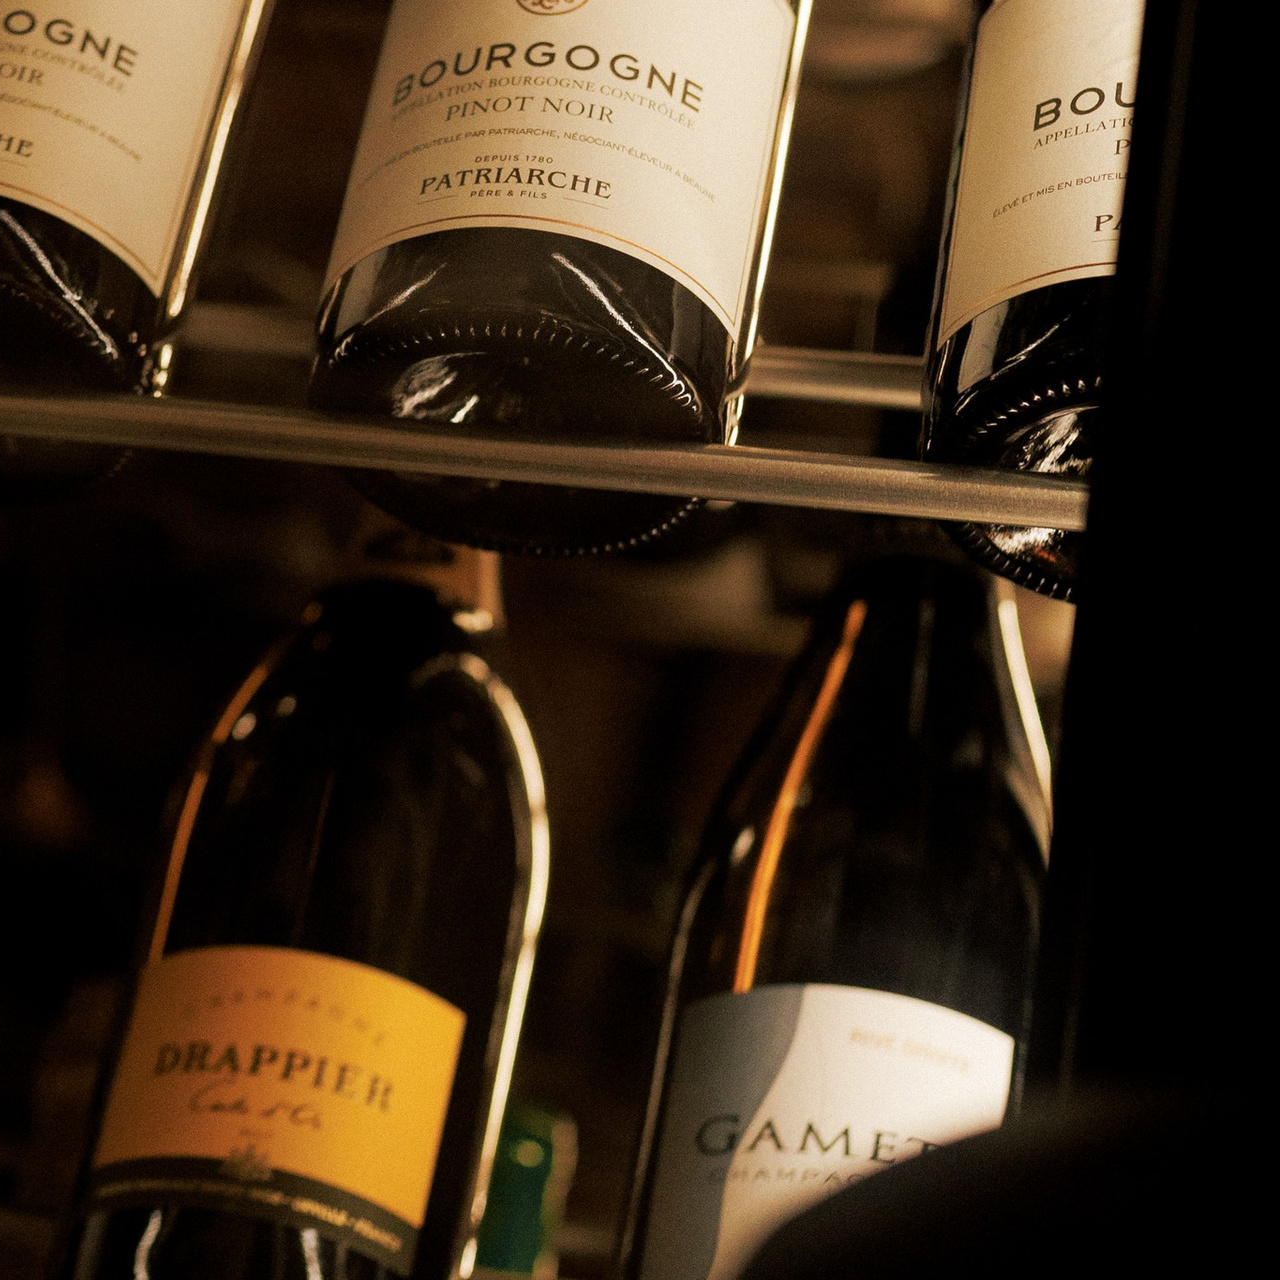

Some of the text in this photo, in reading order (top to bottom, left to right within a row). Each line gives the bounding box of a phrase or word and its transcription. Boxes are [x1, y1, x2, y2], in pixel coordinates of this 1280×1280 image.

[392, 41, 705, 114] BOURGOGNE
[488, 75, 596, 93] BOURGOGNE
[445, 96, 615, 125] PINOT NOIR
[1033, 81, 1136, 133] BOU
[464, 129, 487, 139] PAR
[487, 127, 561, 140] PATRIARCHE,
[474, 154, 554, 165] DEPUIS 1780
[419, 166, 613, 201] PATRIARCHE
[469, 188, 548, 200] PÈRE & FILS
[1021, 192, 1035, 204] ET
[1036, 184, 1056, 198] MIS
[1056, 179, 1073, 191] EN
[1075, 172, 1128, 187] BOUTEIL
[153, 1039, 394, 1113] DRAPPIER
